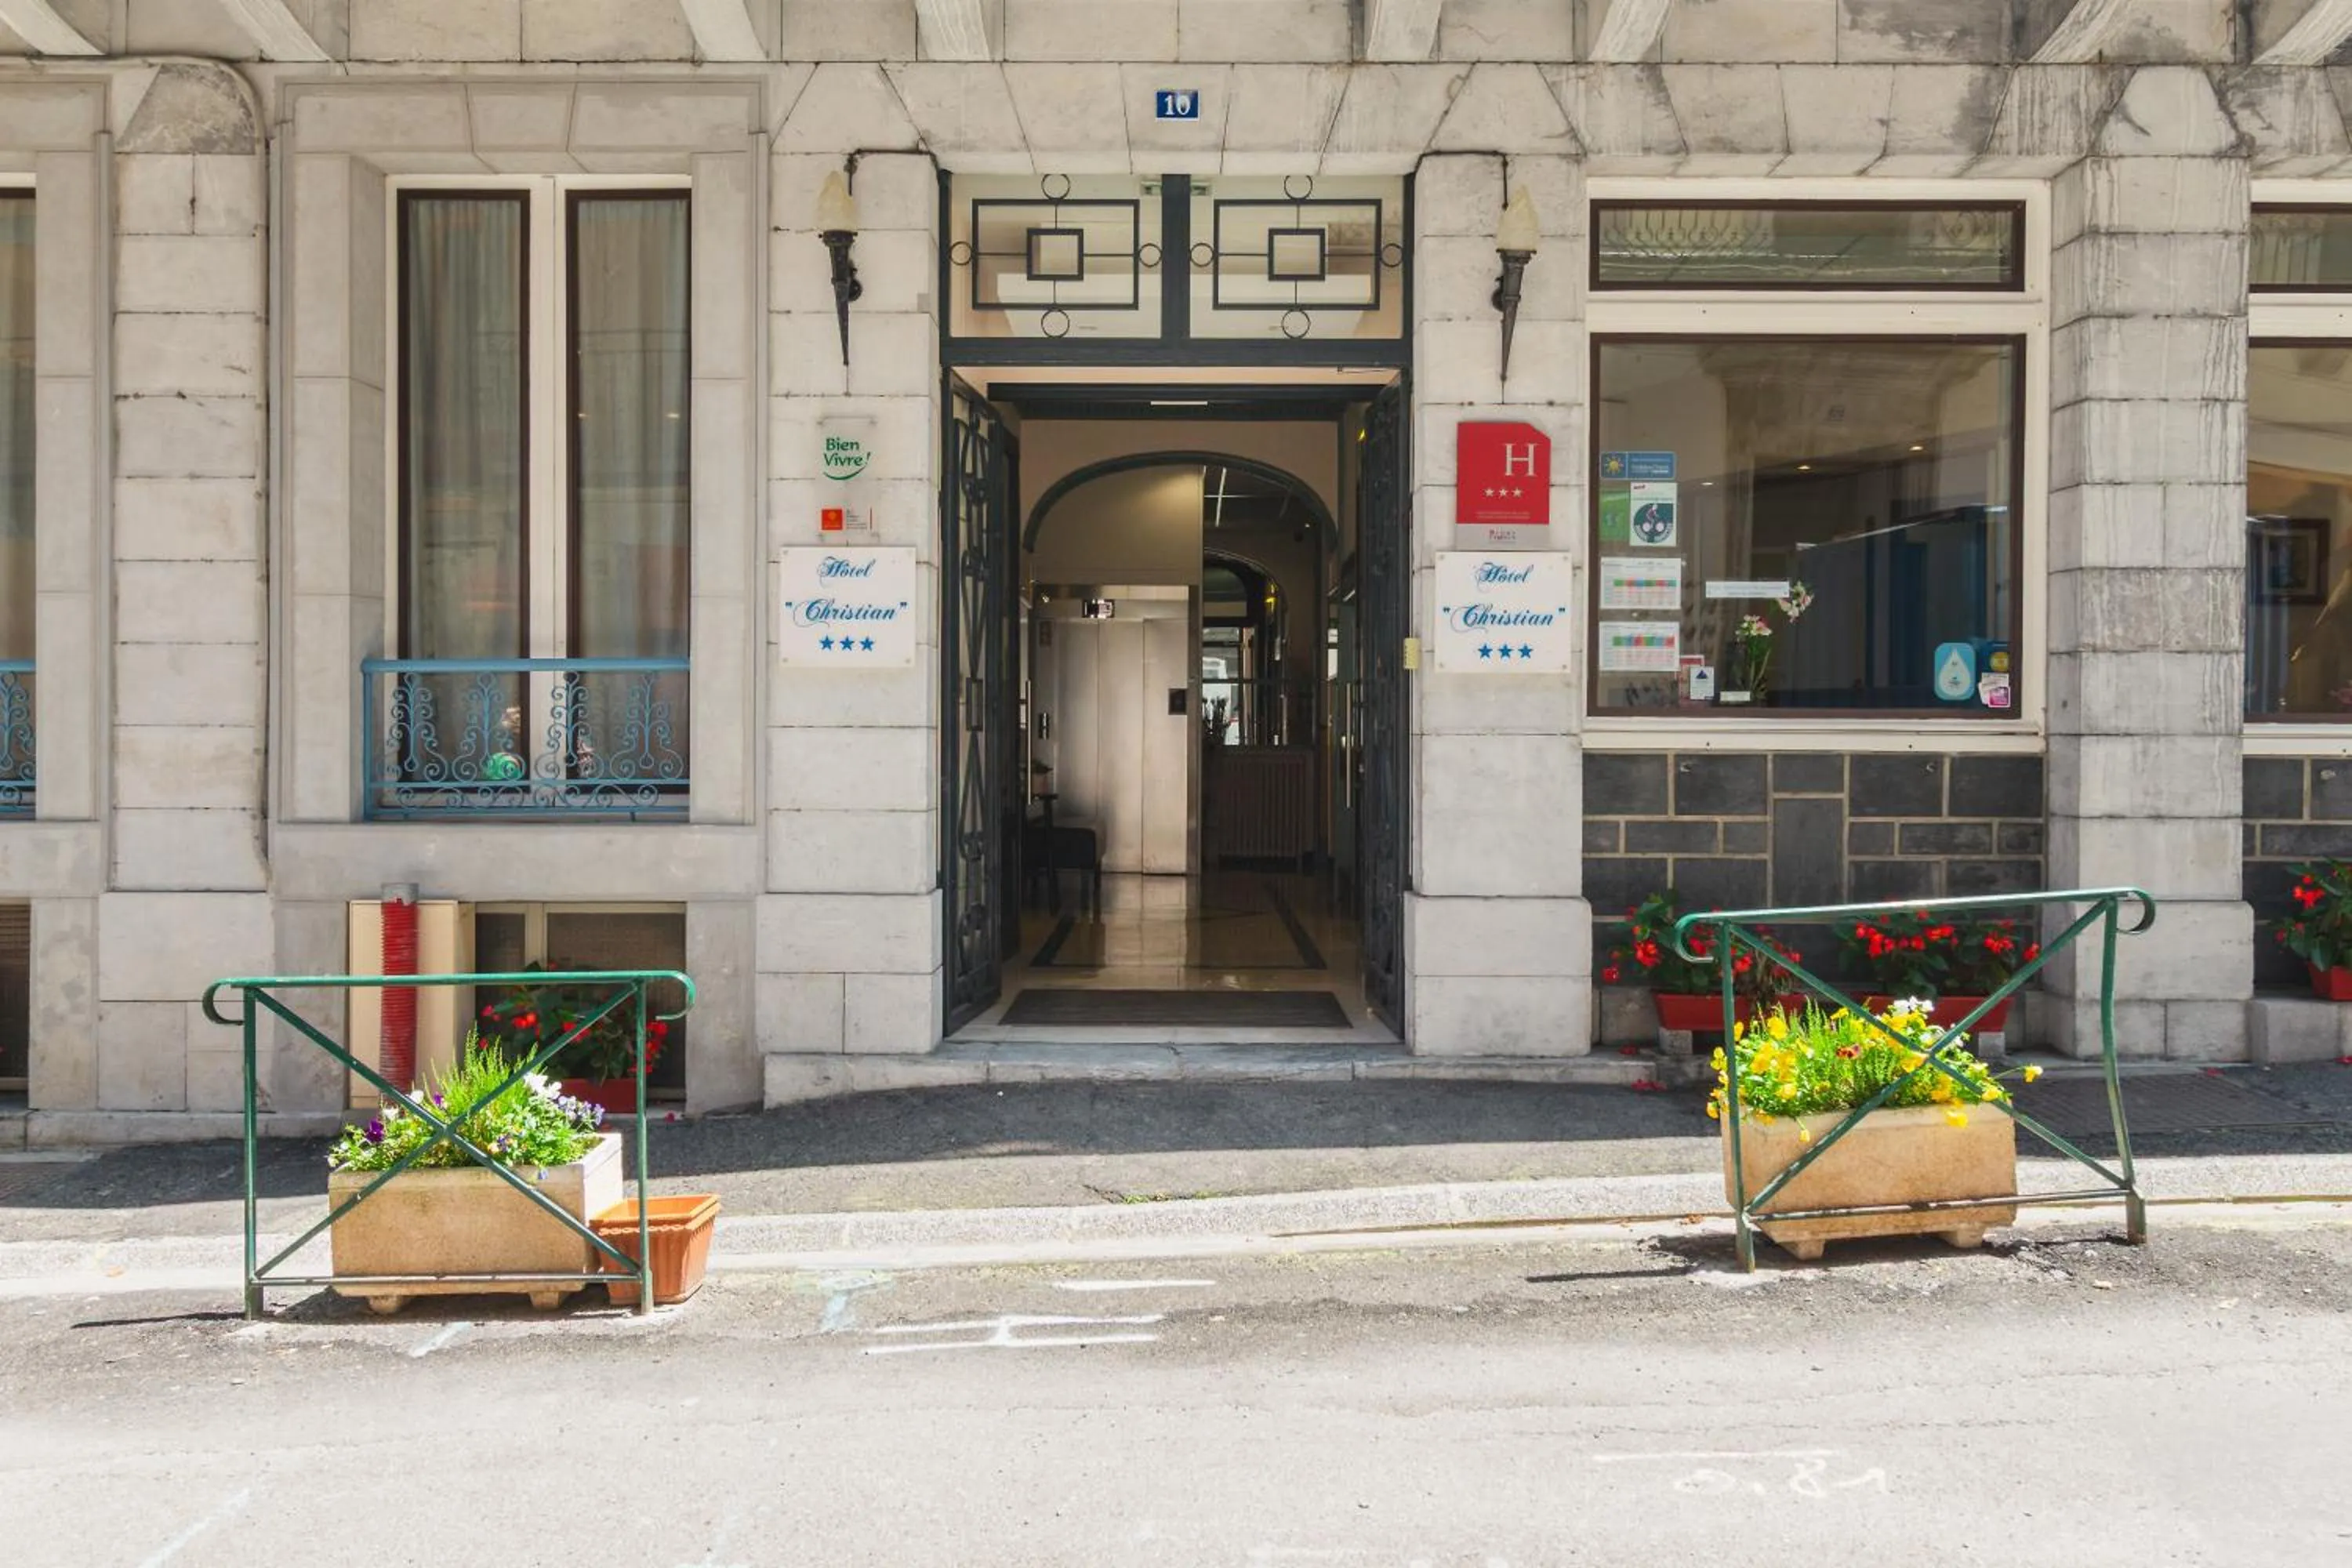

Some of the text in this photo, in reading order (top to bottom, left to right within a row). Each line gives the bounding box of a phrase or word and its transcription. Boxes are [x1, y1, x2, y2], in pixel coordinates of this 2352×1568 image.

[1163, 94, 1191, 115] 10
[826, 437, 859, 451] Bien
[1503, 443, 1538, 477] H
[817, 557, 876, 588] Hôtel
[1475, 563, 1534, 593] Hôtel
